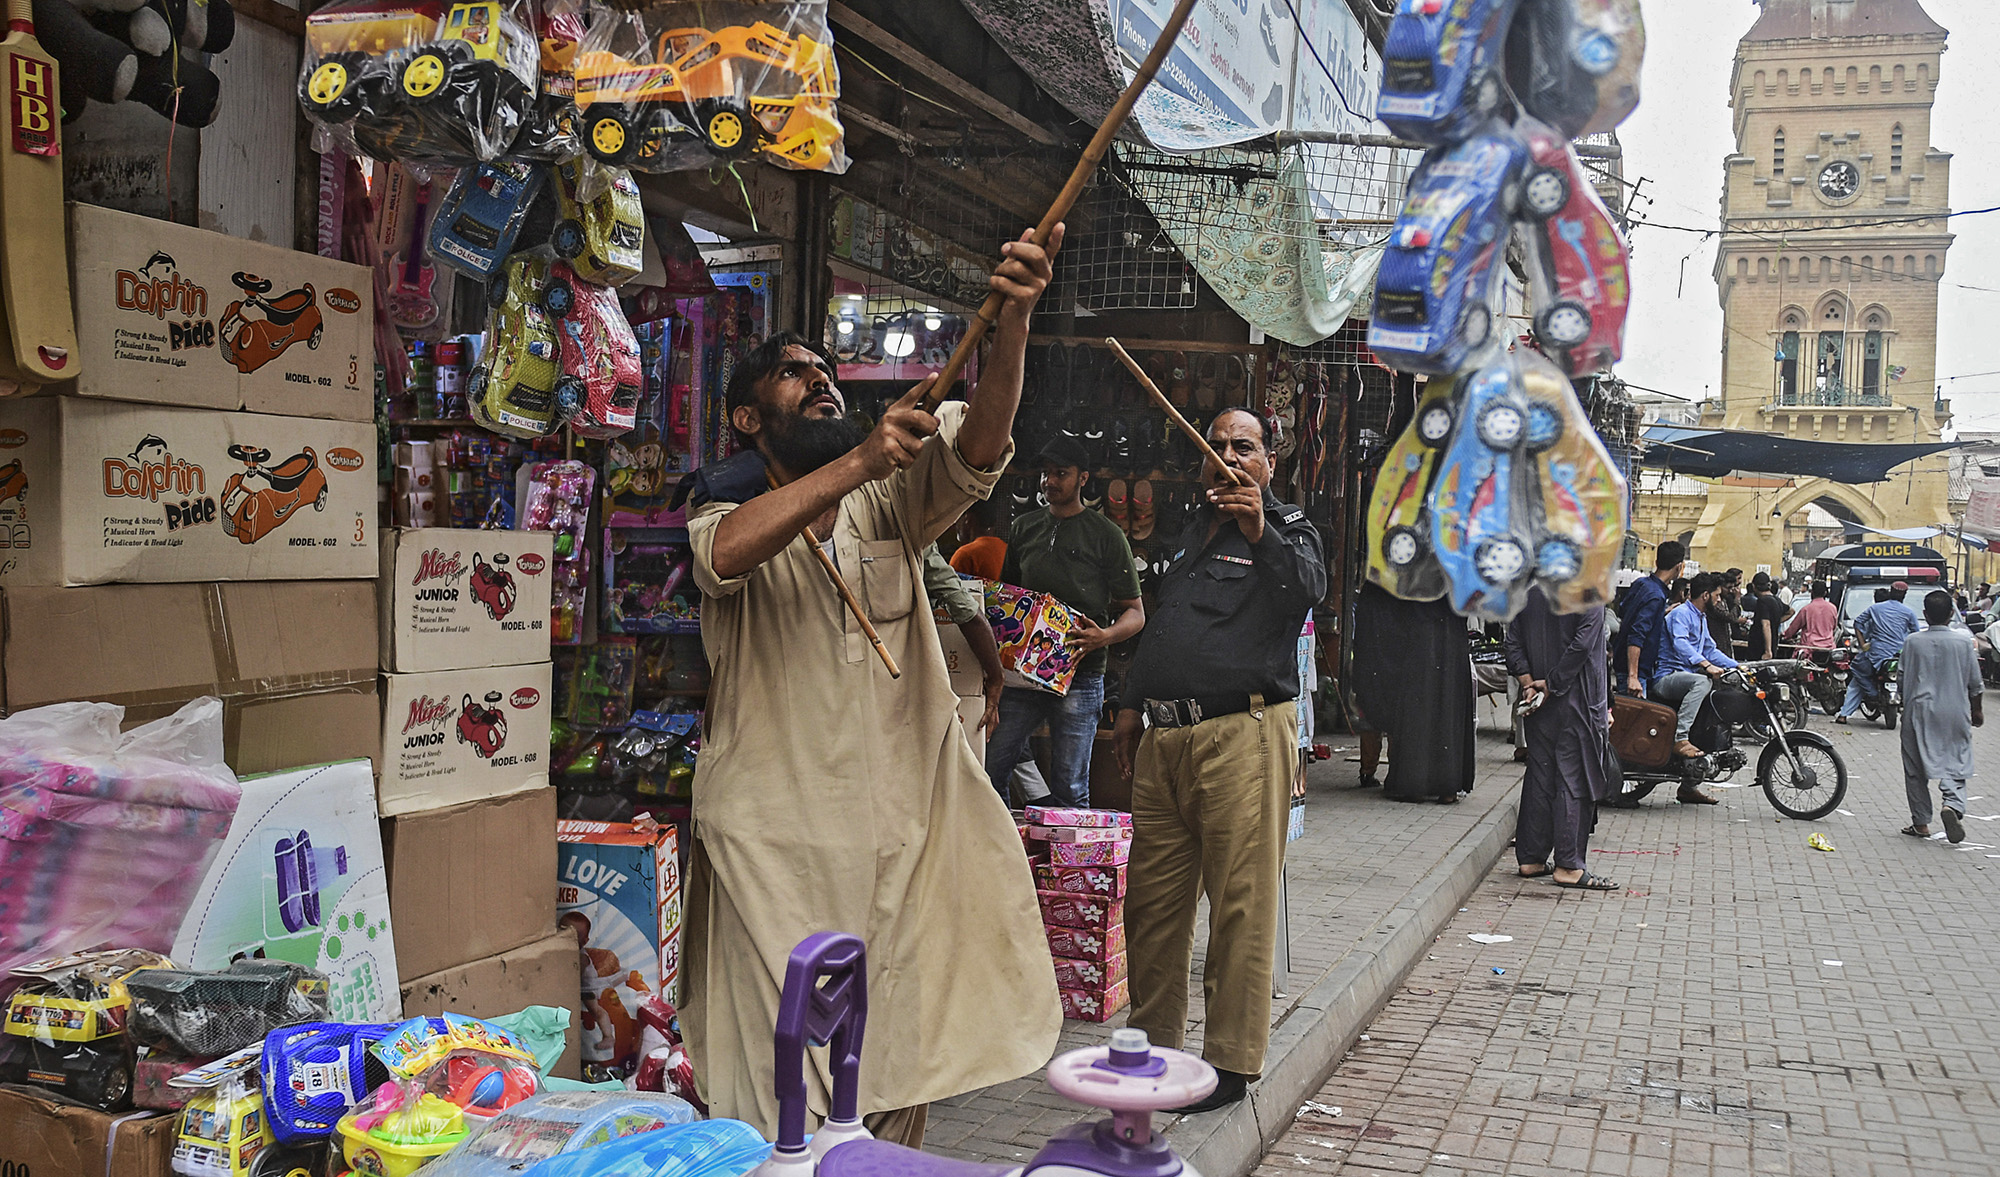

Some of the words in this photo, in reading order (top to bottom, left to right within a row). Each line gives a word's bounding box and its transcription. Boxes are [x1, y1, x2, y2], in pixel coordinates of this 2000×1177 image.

[1122, 16, 1147, 51] Phone
[1326, 29, 1373, 120] HAMZA
[1319, 83, 1343, 133] TOYS
[450, 245, 481, 265] POLICE
[115, 268, 208, 321] Dolphin
[120, 329, 140, 340] Strong
[148, 333, 168, 344] Steady
[167, 319, 217, 352] Ride
[119, 340, 143, 351] Musical
[145, 343, 160, 352] Horn
[119, 351, 148, 362] Indicator
[155, 356, 170, 365] Head
[171, 358, 187, 368] Light
[285, 372, 312, 385] MODEL
[317, 376, 332, 386] 602
[347, 361, 358, 385] 3
[509, 416, 537, 430] POLICE
[102, 452, 206, 503] Dolphin
[19, 507, 27, 520] 3
[109, 517, 133, 525] Strong
[134, 517, 140, 525] &
[141, 517, 164, 526] Steady
[162, 496, 218, 533] Ride
[109, 527, 137, 535] Musical
[354, 518, 365, 542] 3
[110, 539, 142, 547] Indicator
[150, 539, 167, 547] Head
[167, 539, 184, 547] Light
[288, 538, 317, 546] MODEL
[322, 537, 337, 546] 602
[1865, 545, 1911, 557] POLICE
[412, 547, 462, 587] Mini
[415, 588, 460, 602] JUNIOR
[440, 606, 457, 614] Steady
[1049, 606, 1070, 629] DORA
[501, 621, 526, 631] MODEL
[531, 620, 543, 630] 608
[948, 654, 959, 670] 3
[401, 694, 451, 735] Mini
[403, 732, 446, 749] JUNIOR
[490, 755, 519, 768] MODEL
[524, 752, 537, 763] 608
[564, 855, 629, 897] LOVE
[557, 887, 579, 904] KER
[361, 961, 377, 1004] PAK
[342, 984, 355, 1022] Ba
[350, 966, 369, 1022] Mam
[292, 1056, 306, 1092] SPEED
[311, 1070, 323, 1087] 18
[0, 1157, 30, 1177] 00
